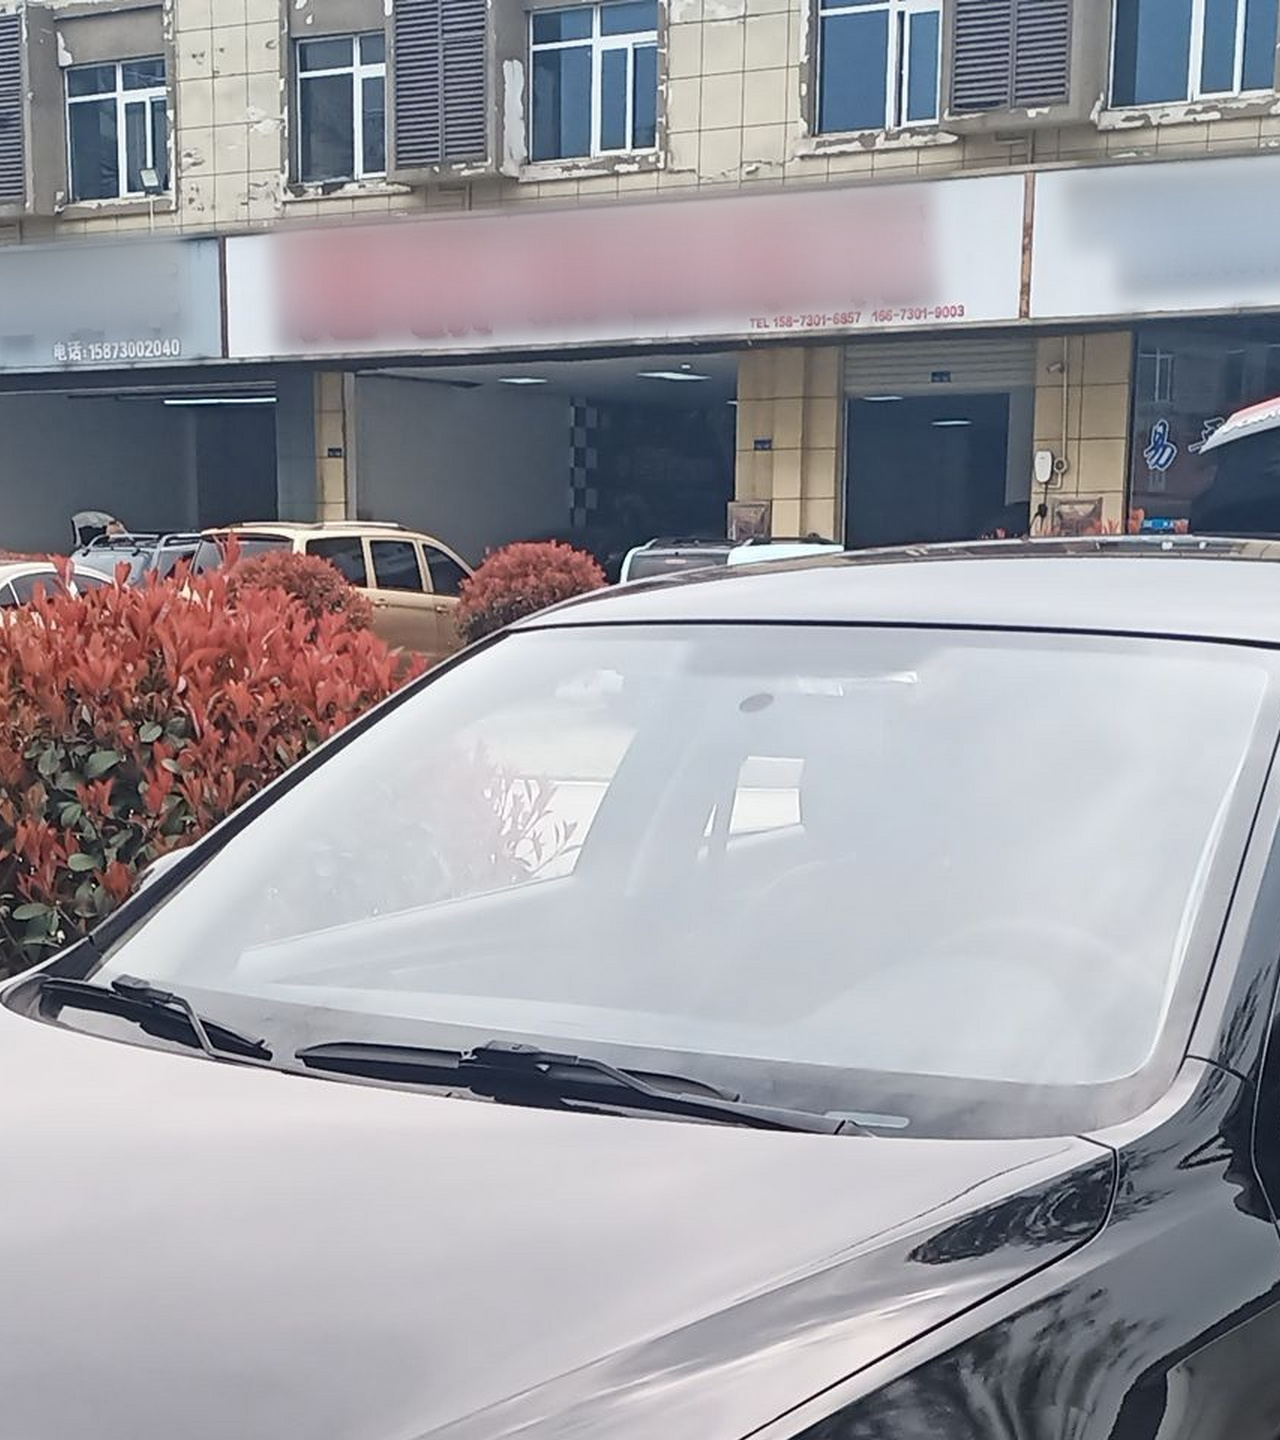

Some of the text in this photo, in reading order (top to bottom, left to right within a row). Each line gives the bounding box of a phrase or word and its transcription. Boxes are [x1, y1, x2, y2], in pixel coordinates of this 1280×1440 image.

[749, 304, 965, 329] TEL 158-7301-6857 166-7301-9003
[54, 338, 180, 361] 电话:15873002040
